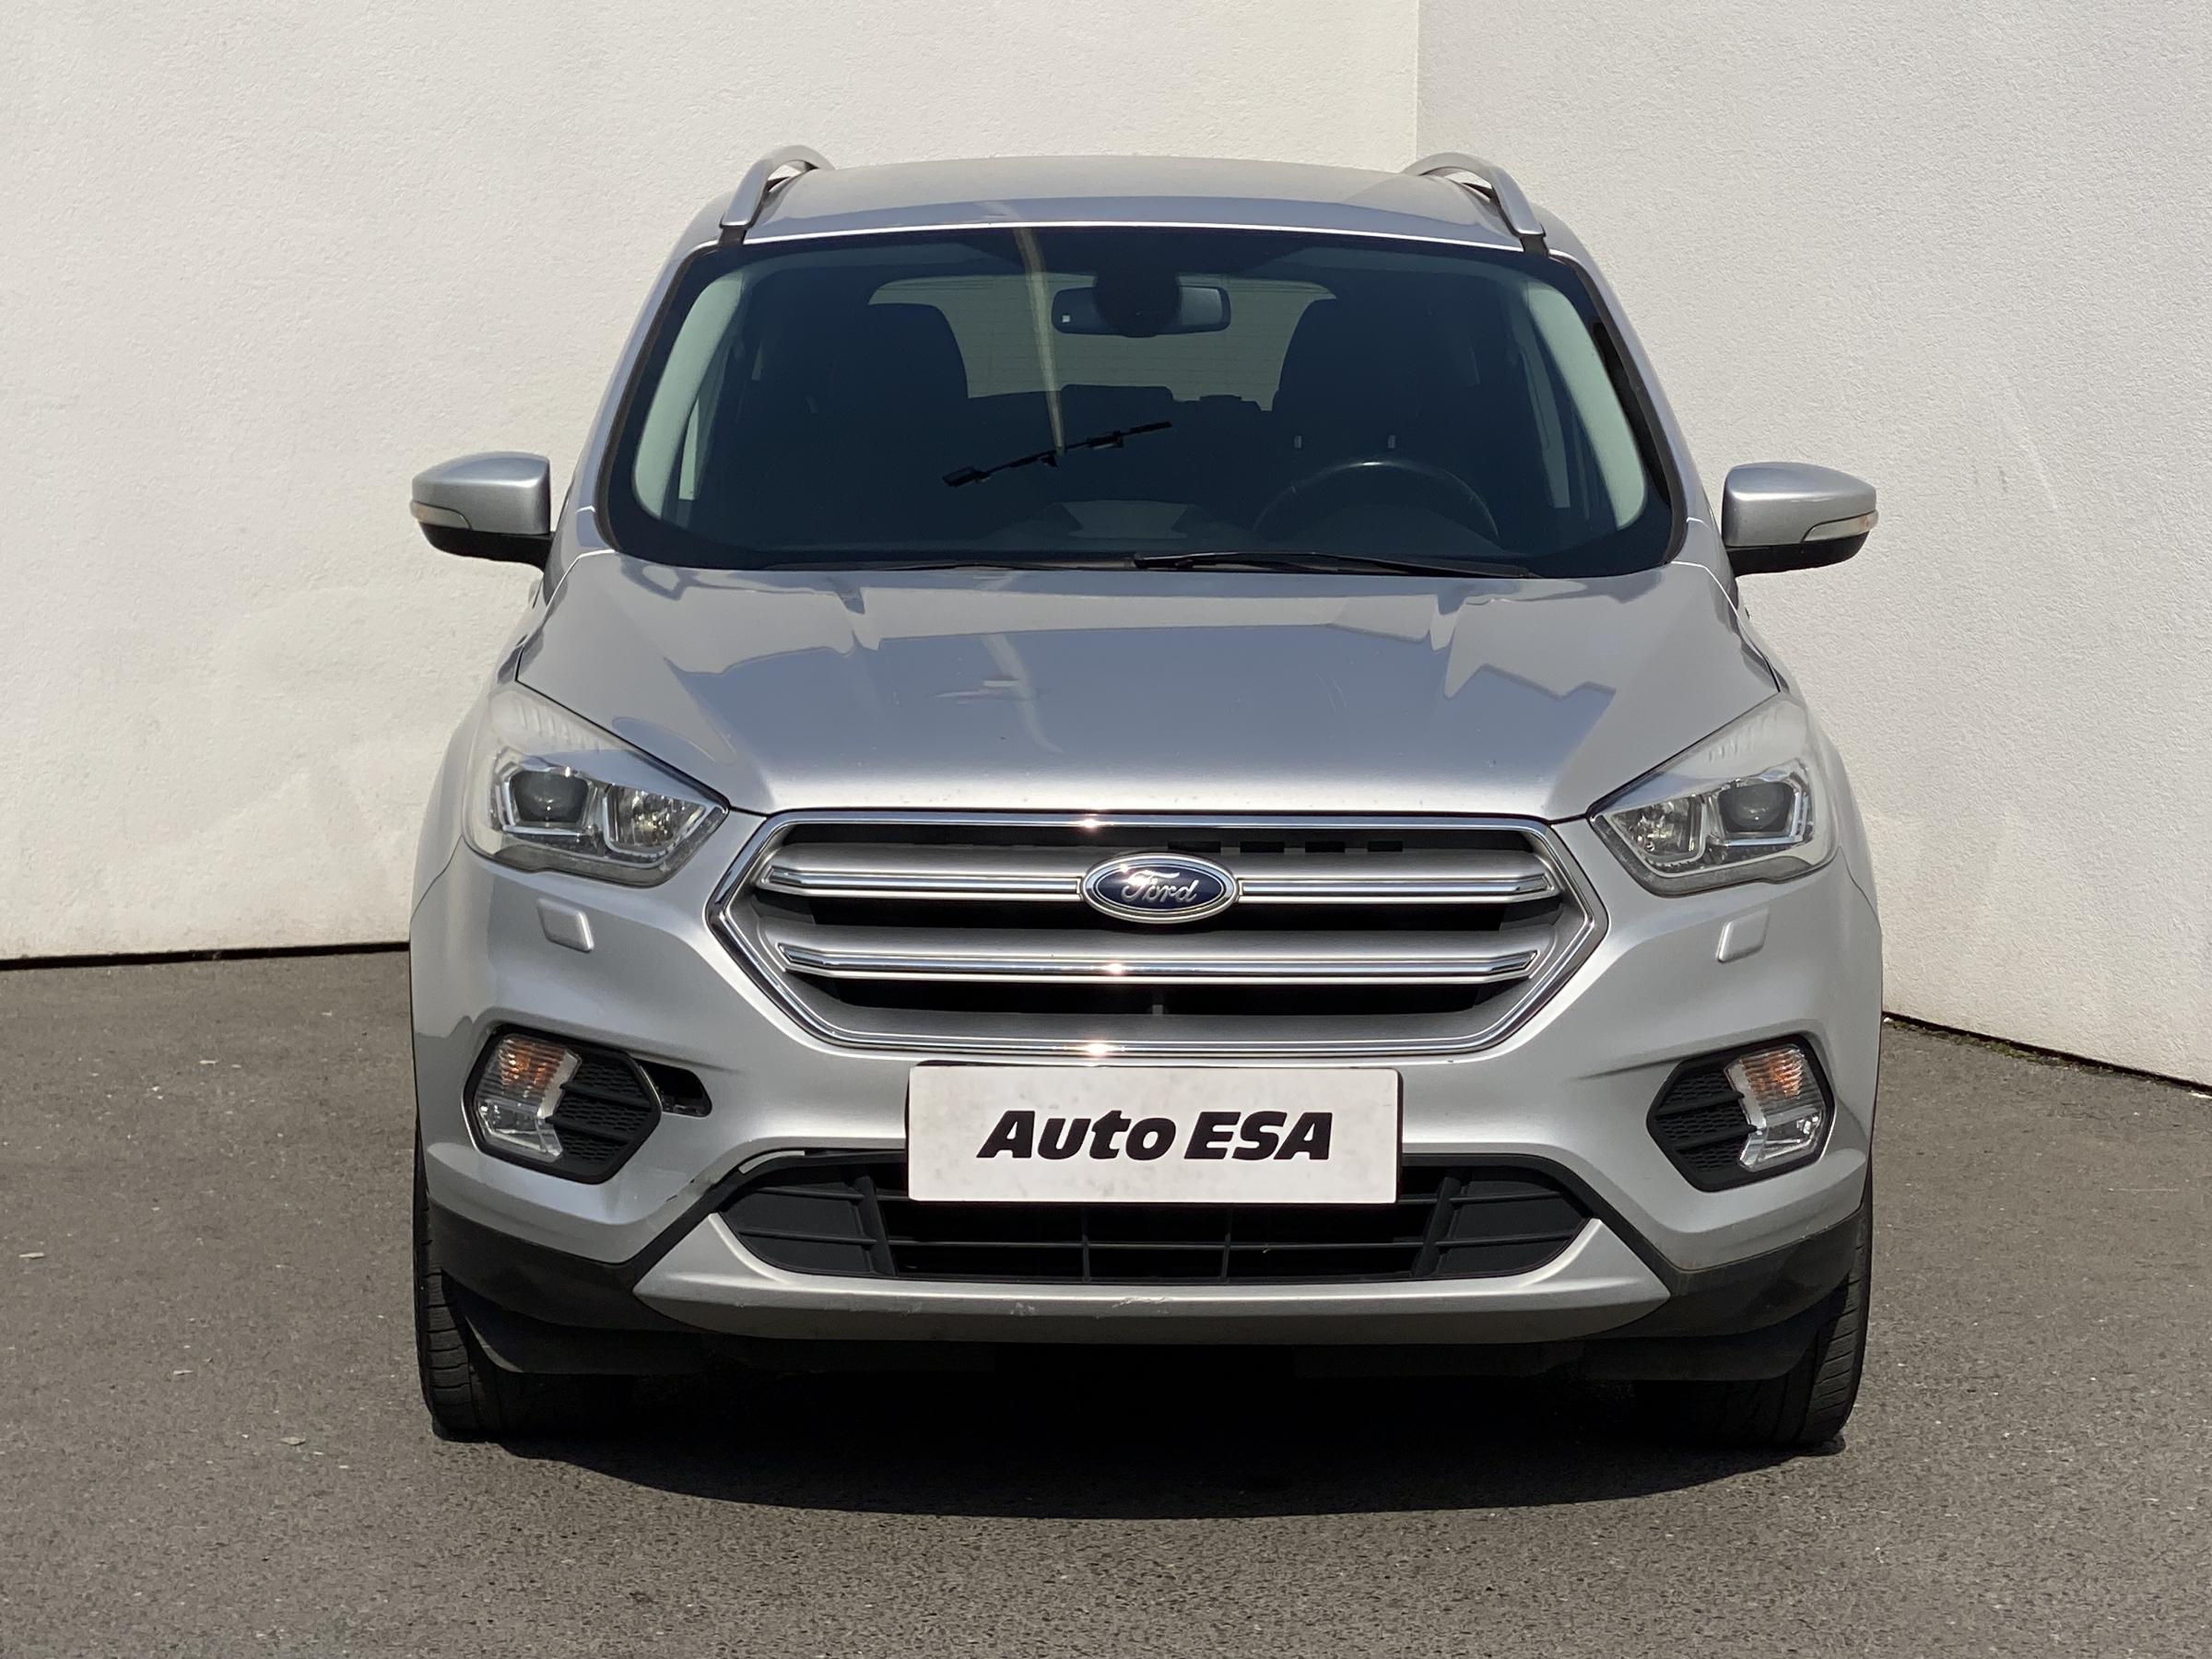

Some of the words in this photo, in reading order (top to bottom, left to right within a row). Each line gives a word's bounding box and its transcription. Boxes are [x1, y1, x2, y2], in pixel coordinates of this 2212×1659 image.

[1121, 870, 1199, 902] Ford
[976, 1109, 1176, 1161] Auto
[1183, 1111, 1333, 1161] ESA
